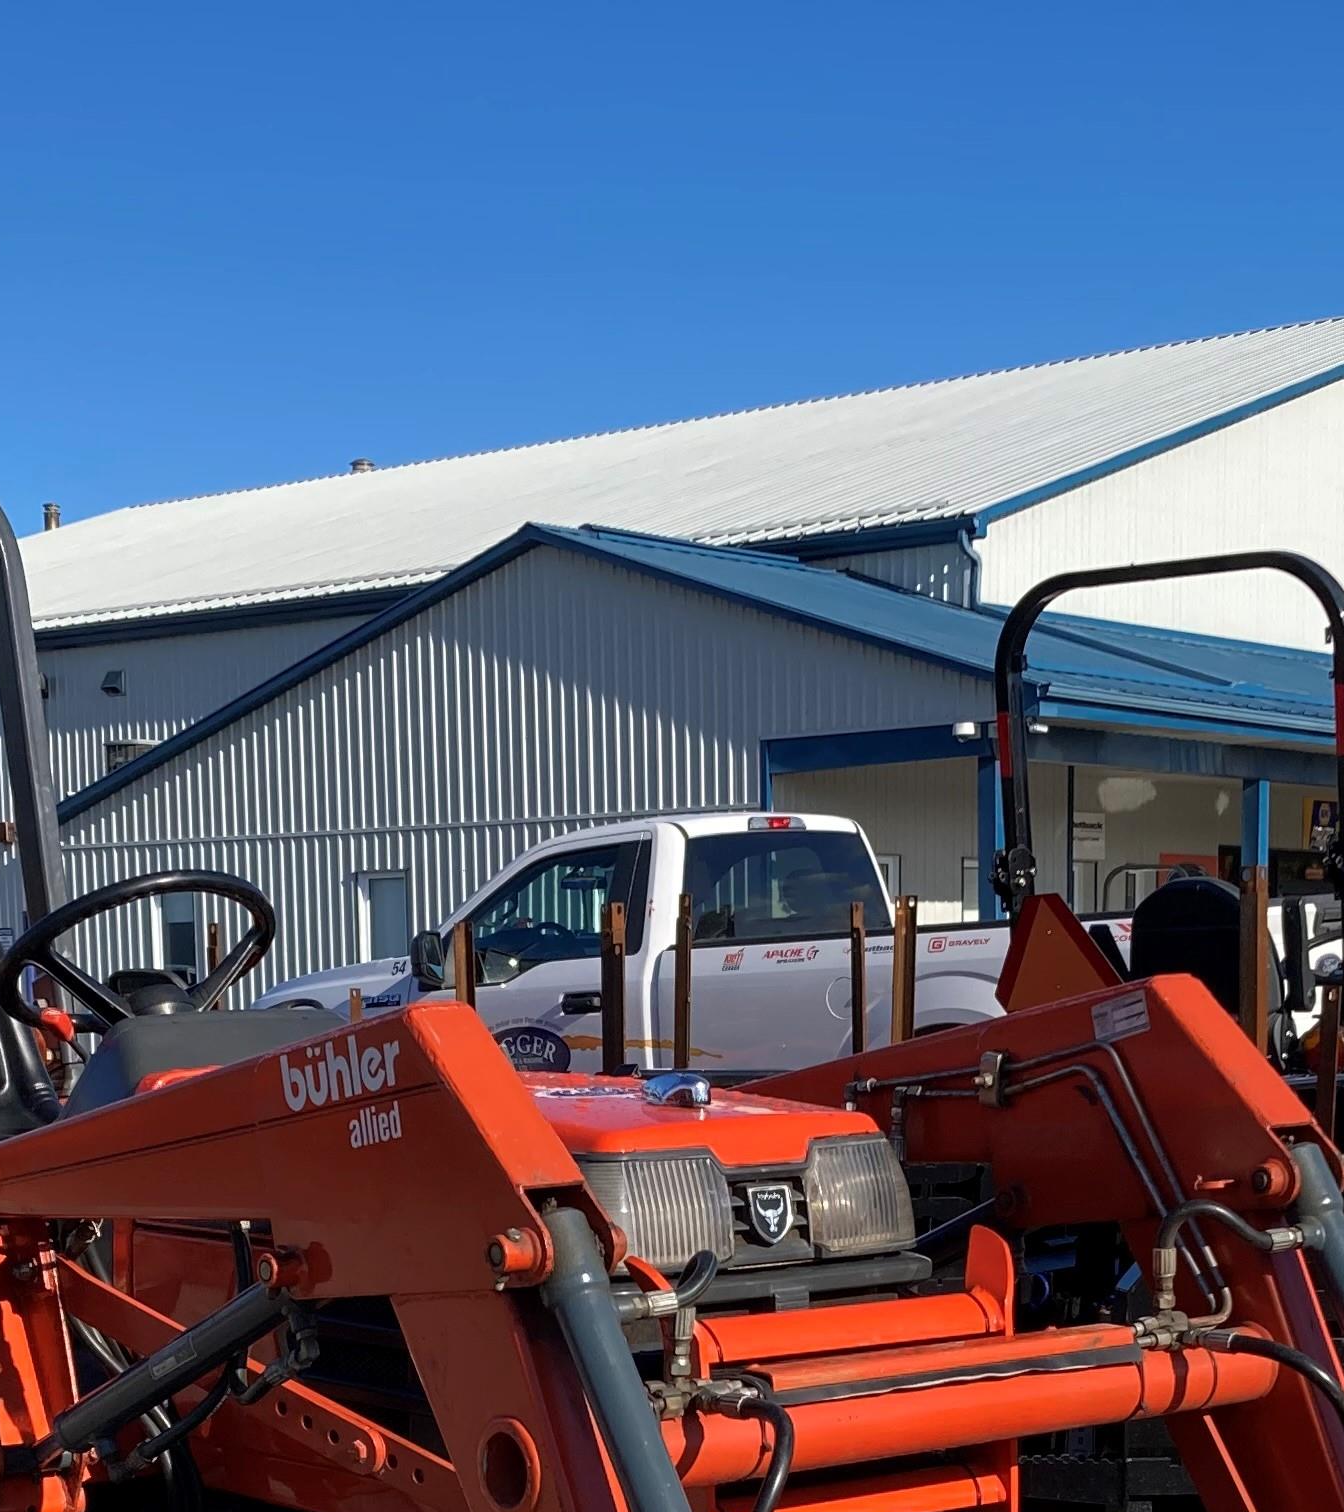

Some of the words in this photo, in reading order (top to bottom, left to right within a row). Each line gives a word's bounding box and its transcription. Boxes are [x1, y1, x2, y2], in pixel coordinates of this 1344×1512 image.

[948, 938, 991, 947] GRAVELY
[763, 948, 806, 960] APACHE
[391, 960, 407, 976] 54
[500, 1034, 556, 1063] GGER
[279, 1034, 400, 1112] bühler
[348, 1100, 402, 1149] allied
